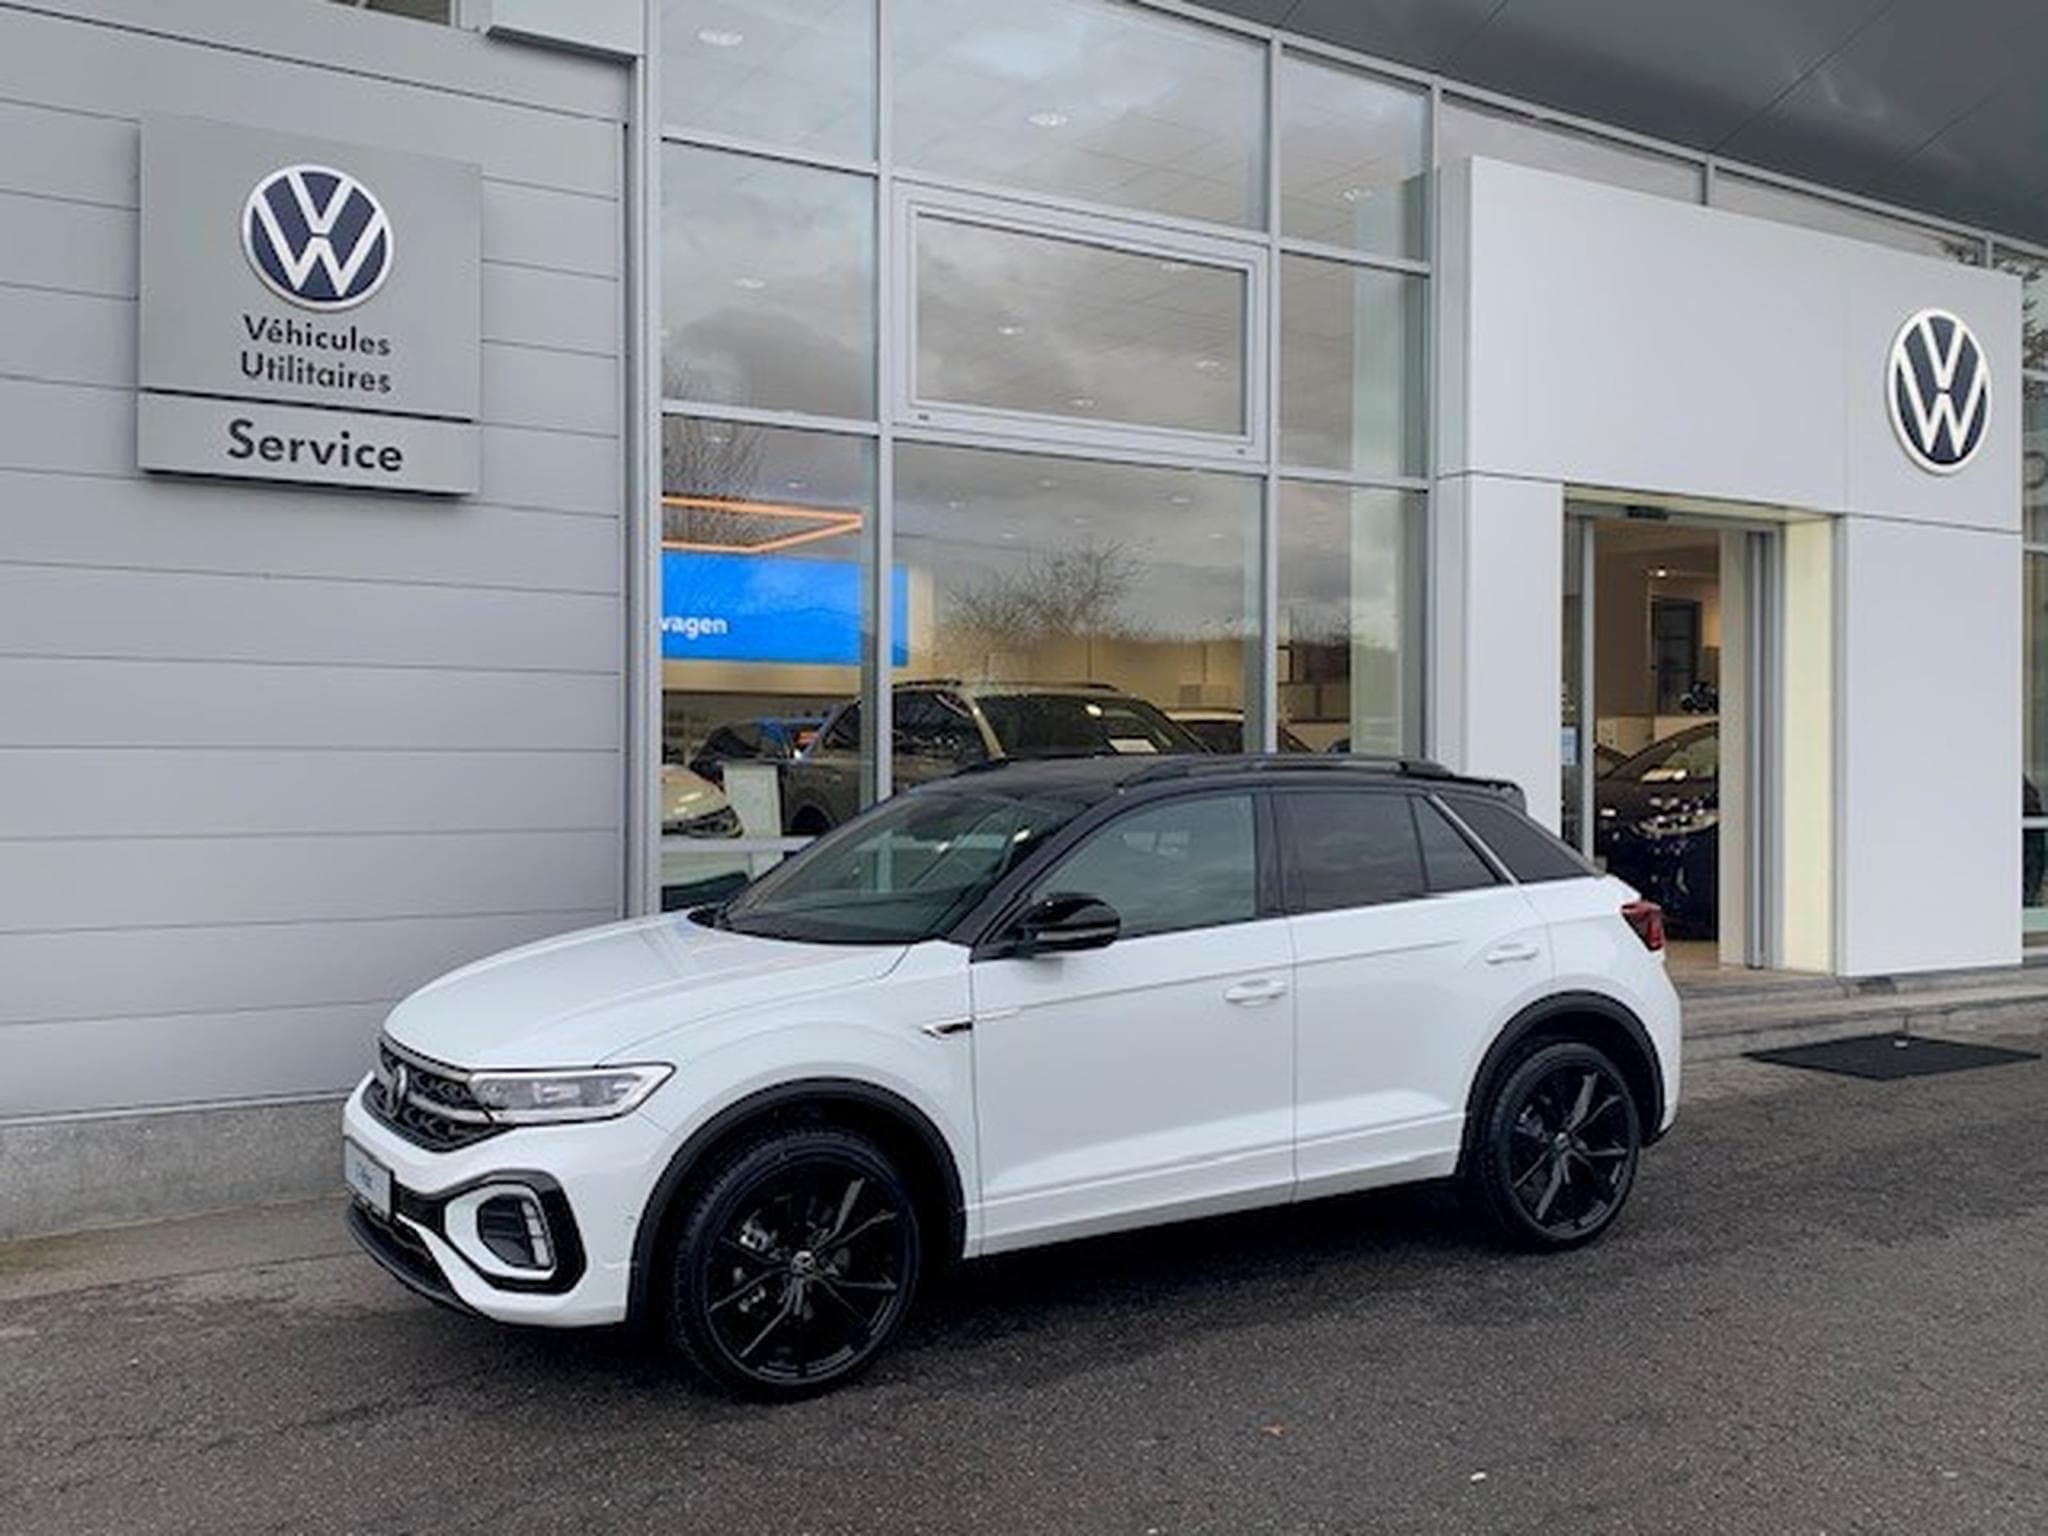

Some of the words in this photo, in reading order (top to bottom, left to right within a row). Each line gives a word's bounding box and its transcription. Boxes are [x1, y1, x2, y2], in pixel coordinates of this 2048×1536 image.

[242, 313, 391, 355] Véhicules
[240, 350, 392, 394] Utilitaires
[226, 418, 403, 472] Service
